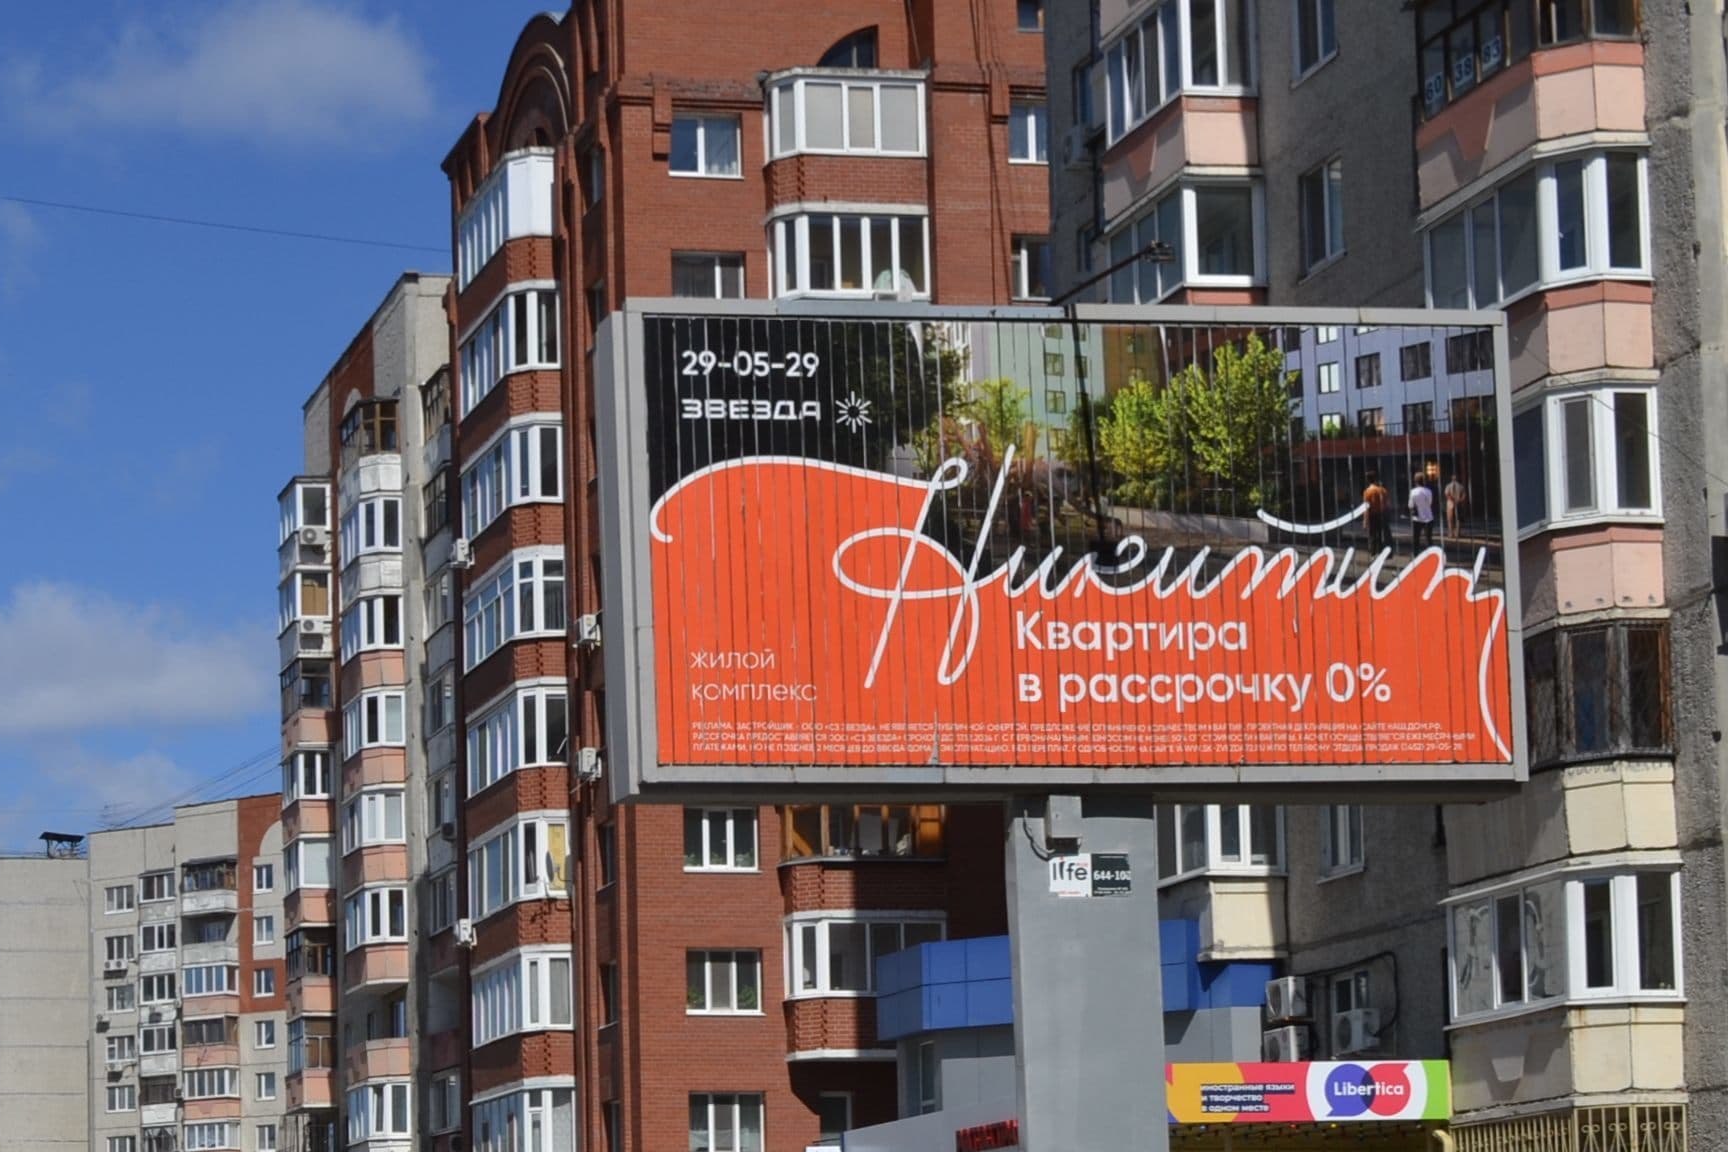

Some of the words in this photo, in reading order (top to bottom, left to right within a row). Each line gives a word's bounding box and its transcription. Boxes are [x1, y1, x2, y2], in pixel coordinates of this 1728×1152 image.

[681, 350, 820, 377] 29-05-29
[681, 398, 821, 421] ЗВЕЗДА
[1016, 609, 1248, 660] Квартира
[690, 648, 775, 669] жилой
[691, 682, 817, 702] комплекс
[1018, 674, 1043, 703] в
[1058, 672, 1312, 713] рассрочку
[1325, 661, 1392, 703] 0%
[1334, 1081, 1404, 1097] Libertica
